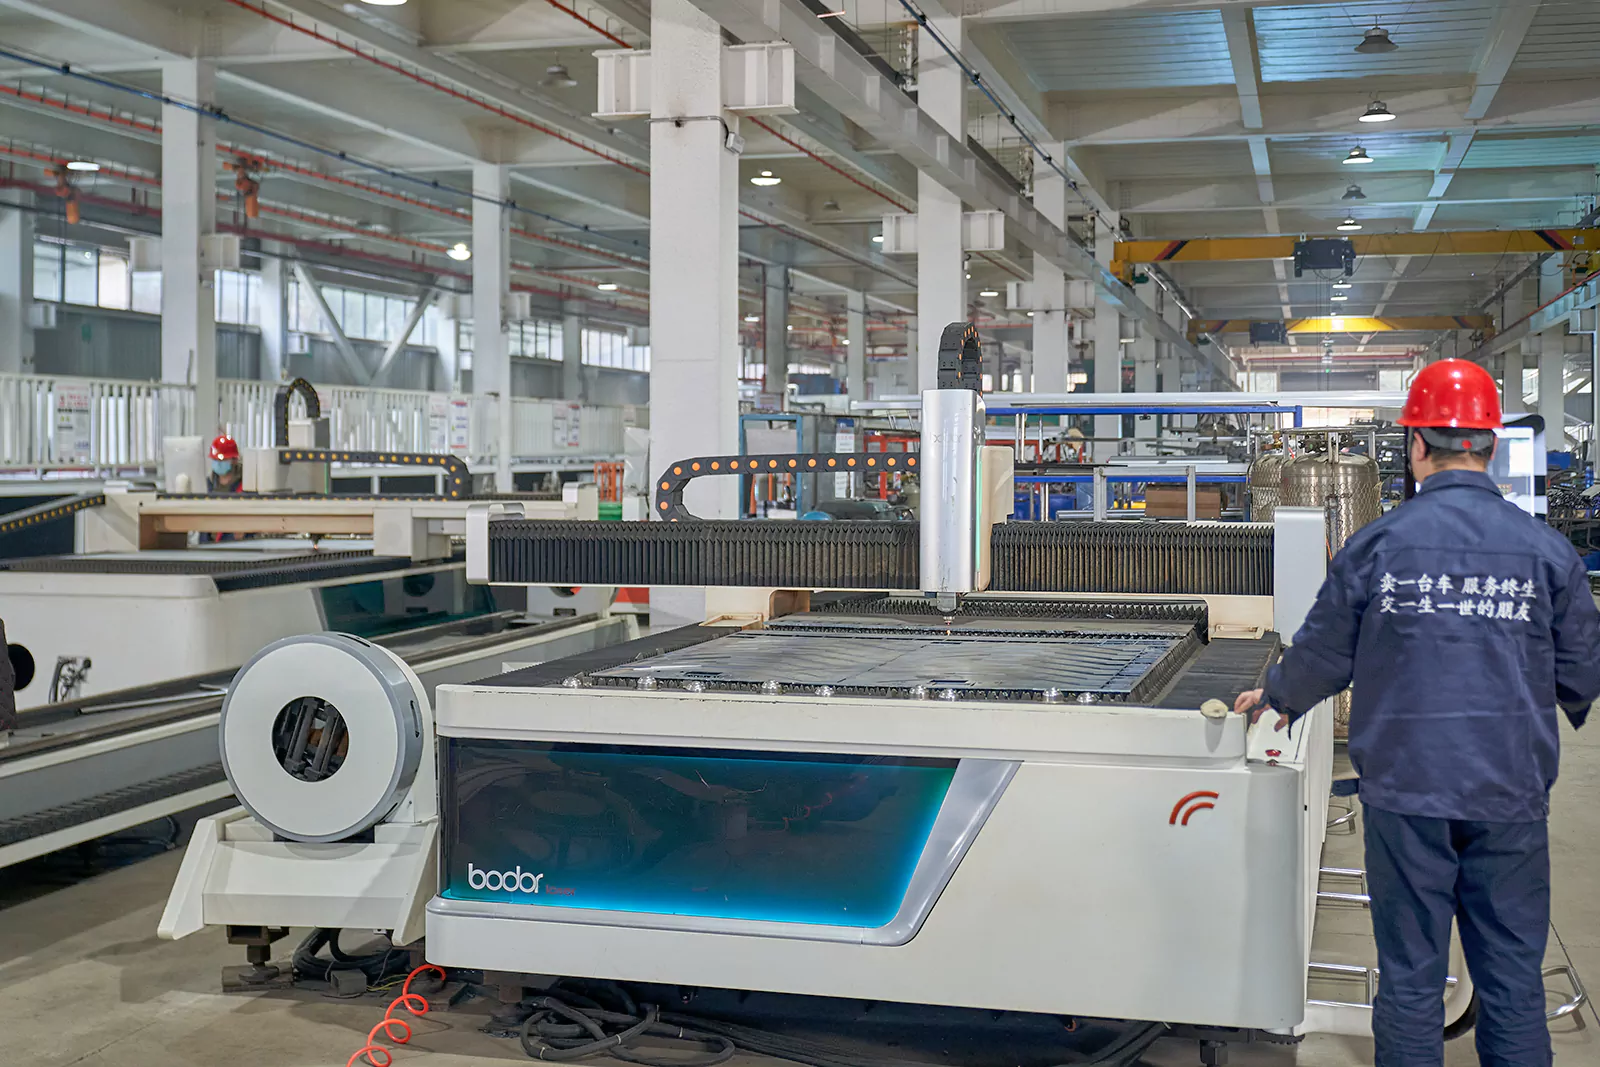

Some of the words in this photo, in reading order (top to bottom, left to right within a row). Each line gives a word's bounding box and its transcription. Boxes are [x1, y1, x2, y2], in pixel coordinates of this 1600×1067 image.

[1380, 572, 1453, 595] 卖一台车
[1461, 576, 1536, 598] 服务终生
[1380, 595, 1531, 621] 交一生一世的朋友
[468, 863, 543, 893] bodor
